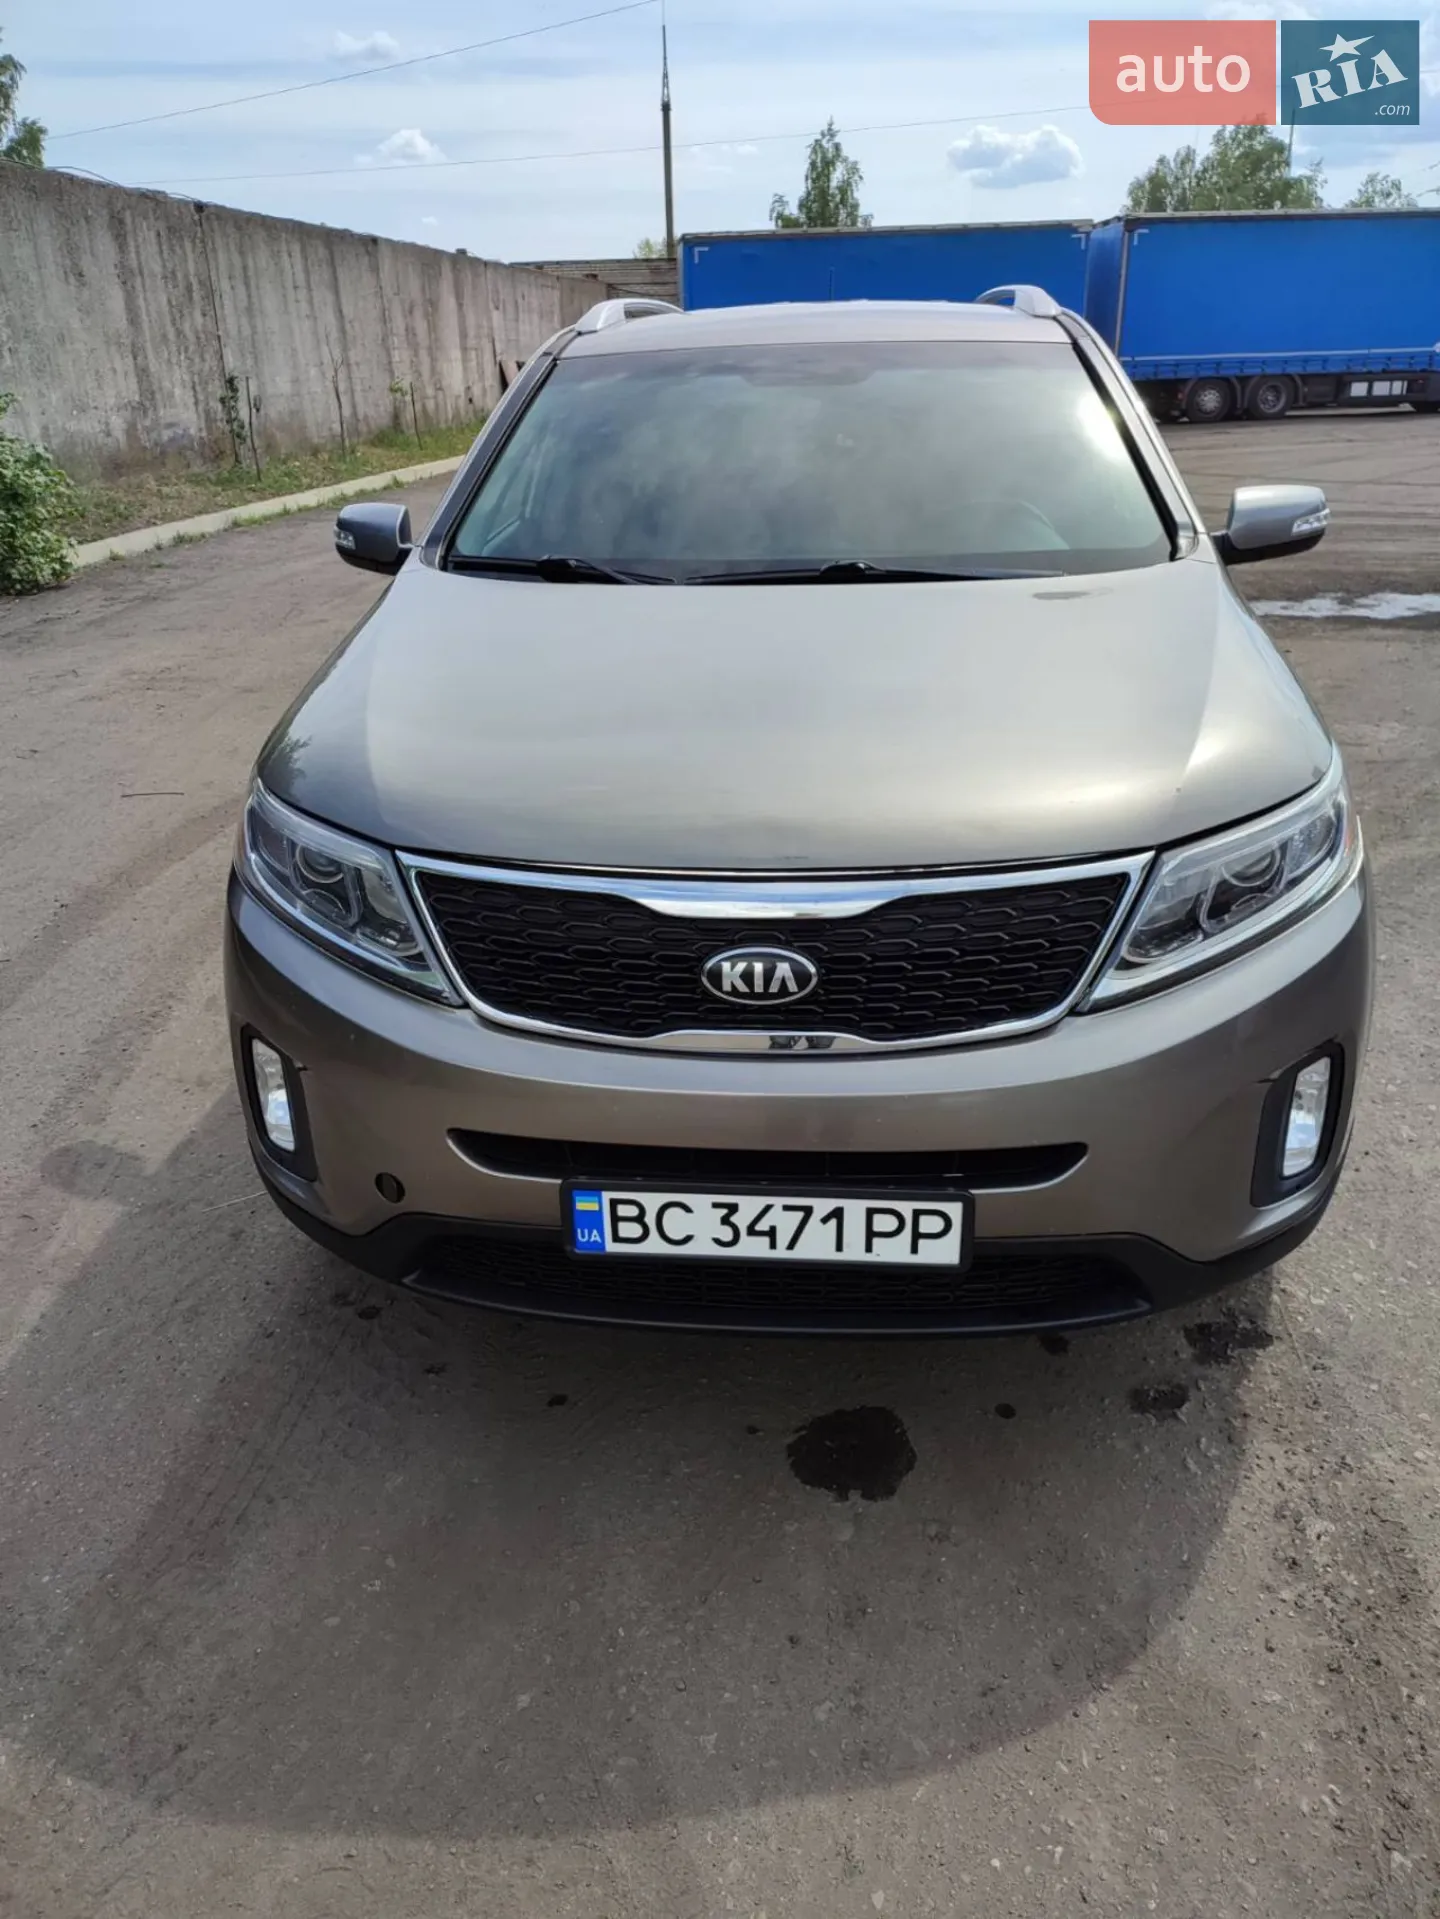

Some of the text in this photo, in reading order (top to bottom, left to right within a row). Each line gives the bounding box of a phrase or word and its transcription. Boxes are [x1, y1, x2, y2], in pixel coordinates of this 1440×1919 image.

[721, 961, 799, 993] KIA
[577, 1228, 602, 1244] UA
[608, 1197, 953, 1255] BC 3471 PP
